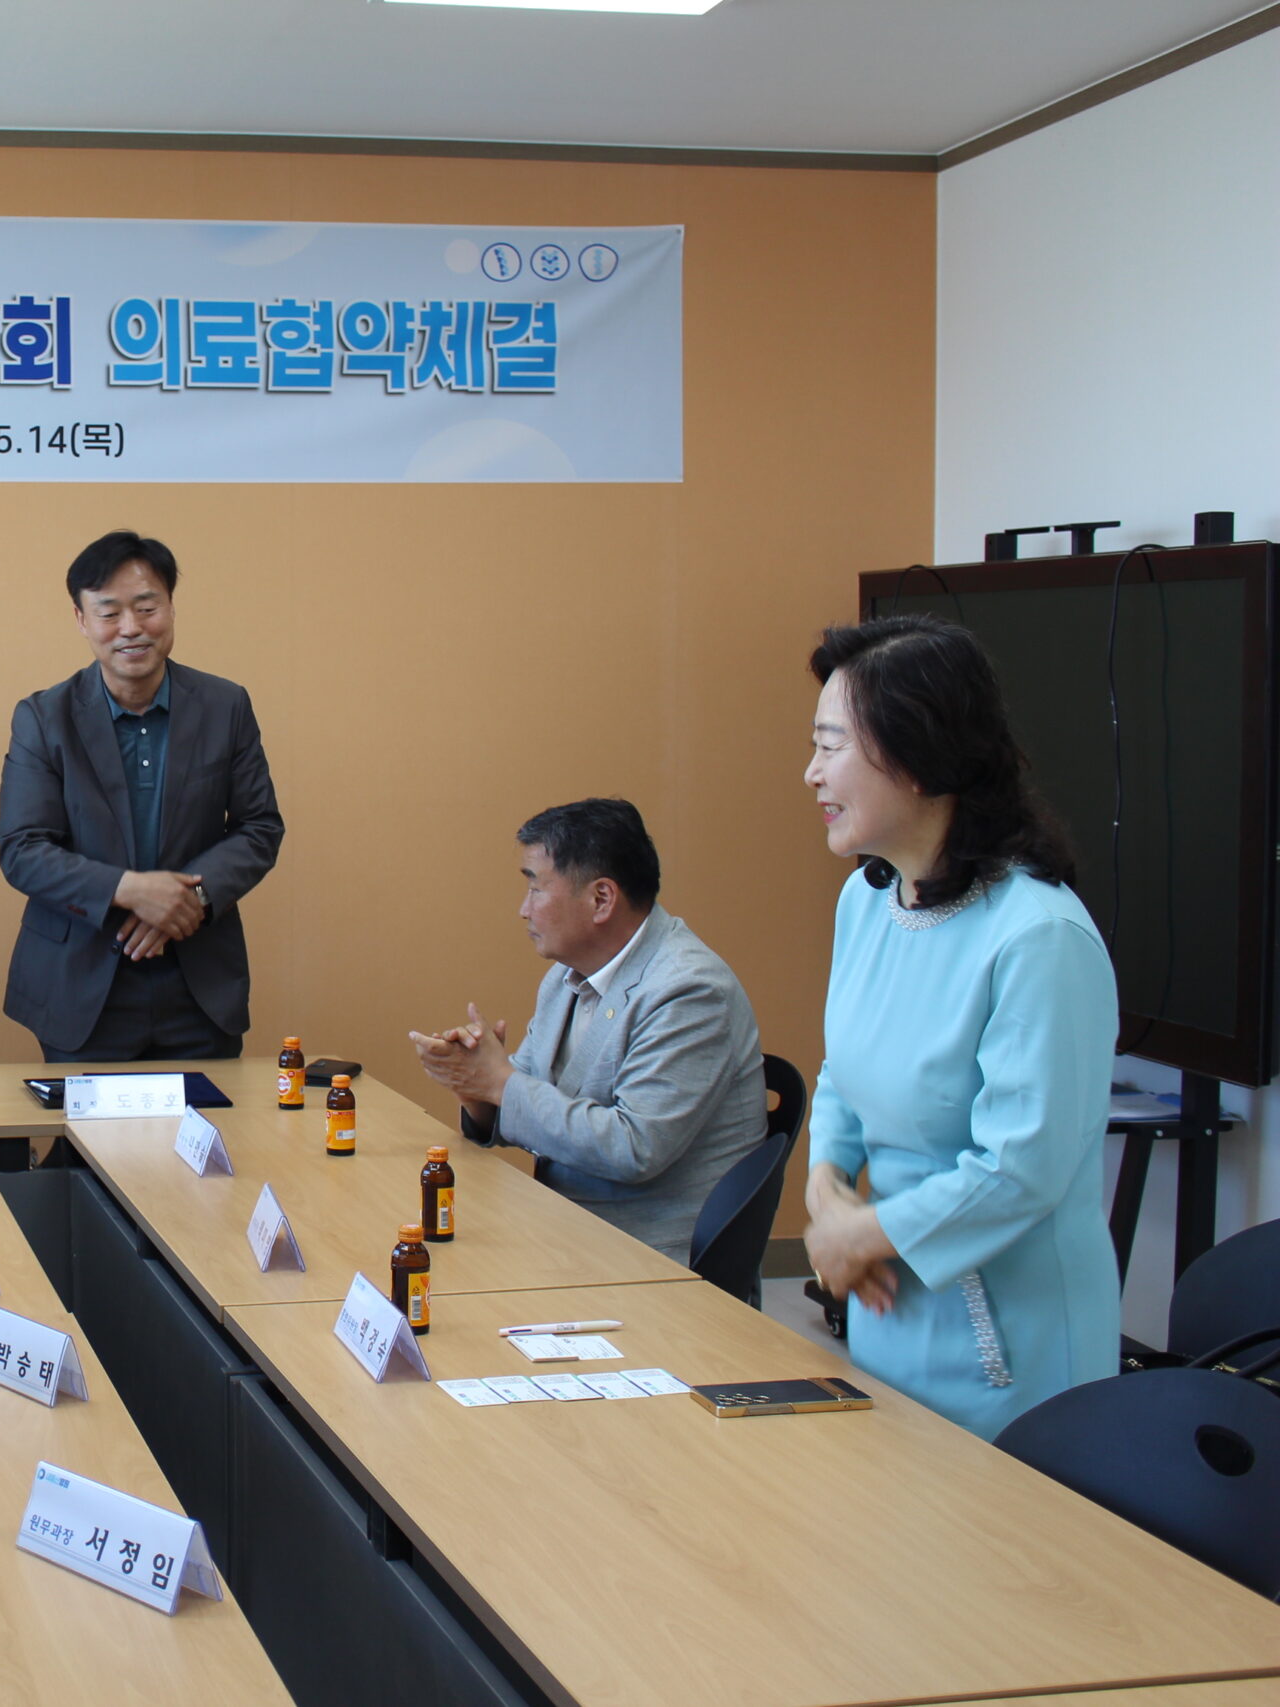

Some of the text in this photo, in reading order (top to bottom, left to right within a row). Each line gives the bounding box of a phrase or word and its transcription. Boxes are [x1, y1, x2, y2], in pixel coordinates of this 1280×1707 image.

[108, 296, 559, 394] 의료협약체결
[29, 1513, 174, 1590] 원무과장 서정임
